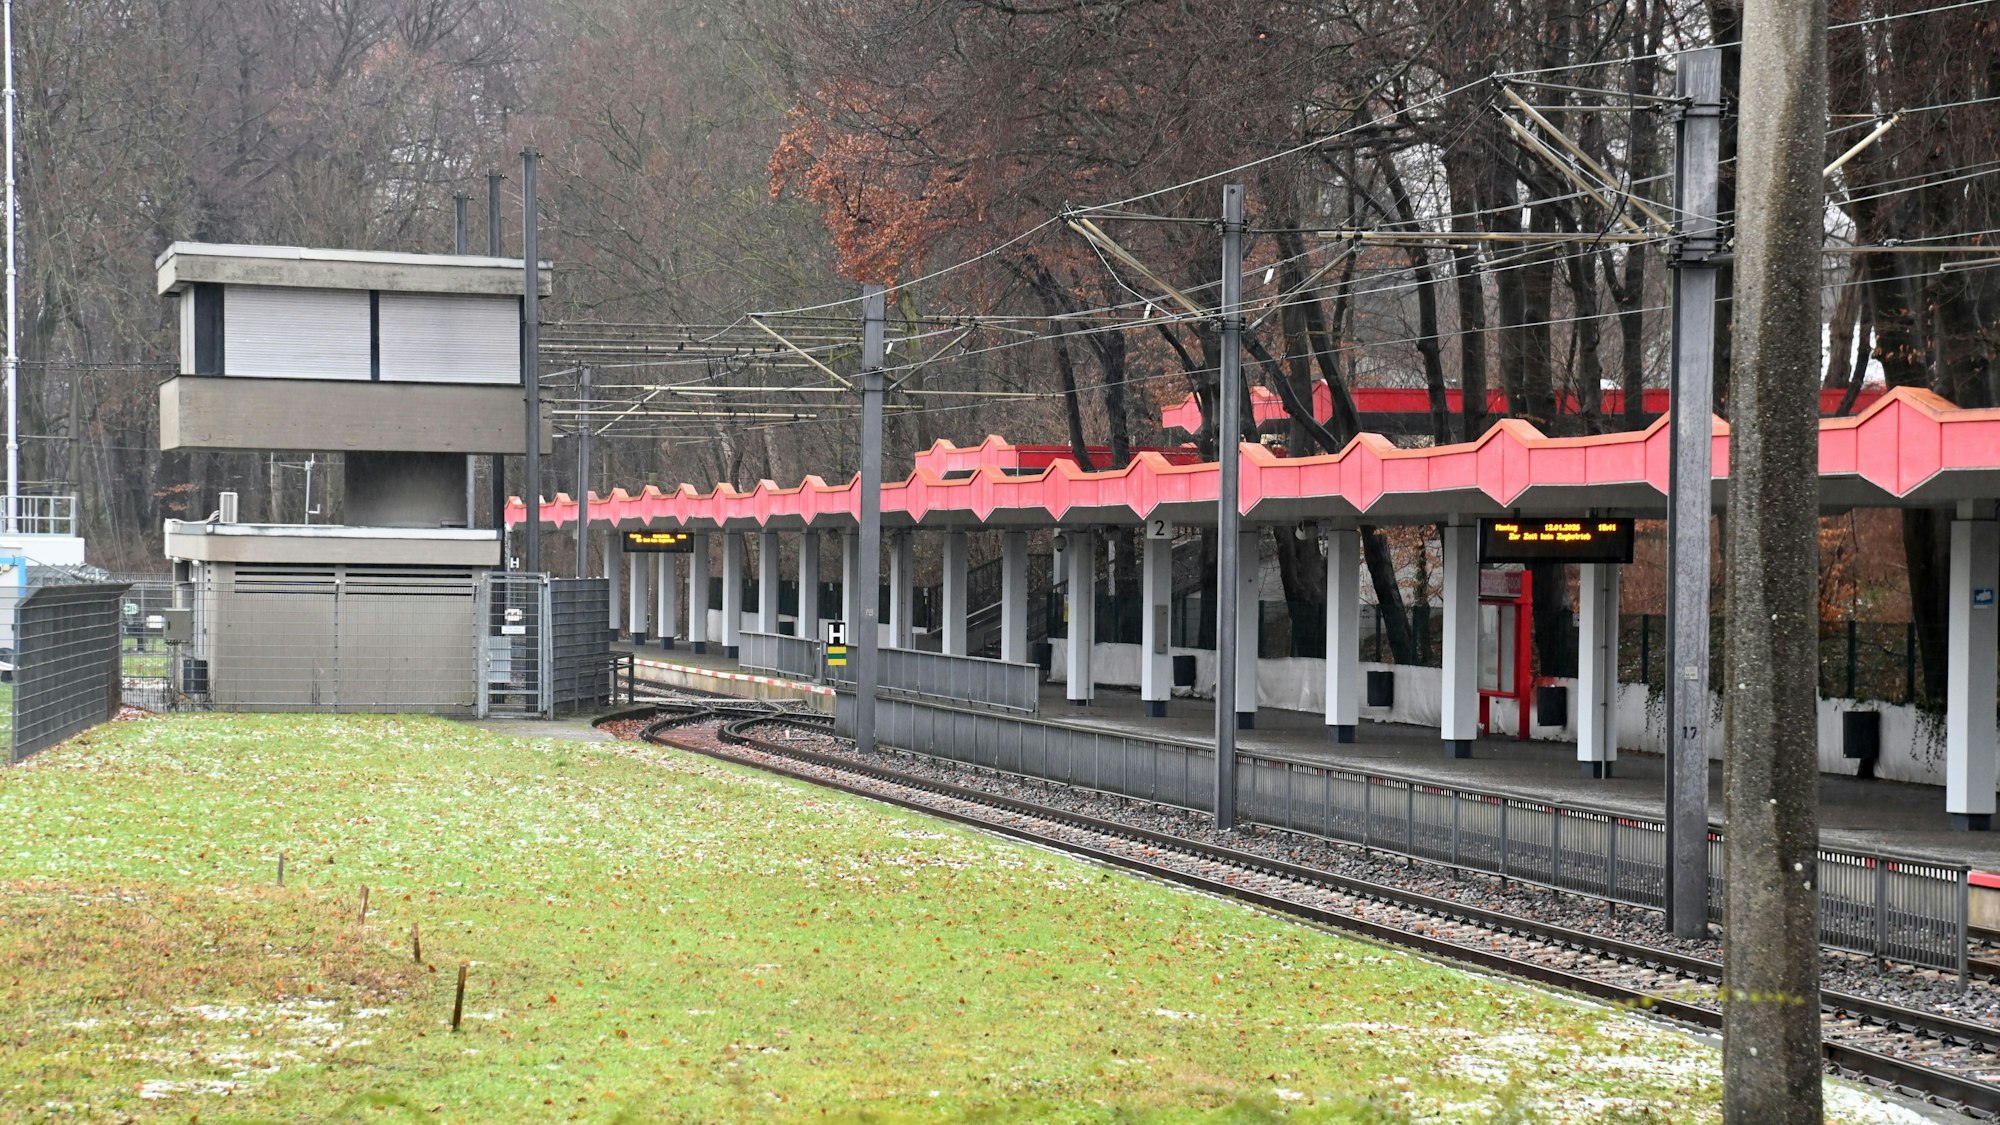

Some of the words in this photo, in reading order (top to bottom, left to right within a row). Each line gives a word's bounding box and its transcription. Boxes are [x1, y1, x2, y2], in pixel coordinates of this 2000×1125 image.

[1155, 520, 1165, 536] 2
[1495, 523, 1518, 533] Montag
[1508, 532, 1521, 541] Zur
[1523, 532, 1538, 541] Zeit
[1540, 532, 1554, 541] kein
[1556, 532, 1592, 542] Zugbetrieb
[510, 557, 520, 569] H
[828, 624, 845, 644] H
[1683, 726, 1697, 739] 17
